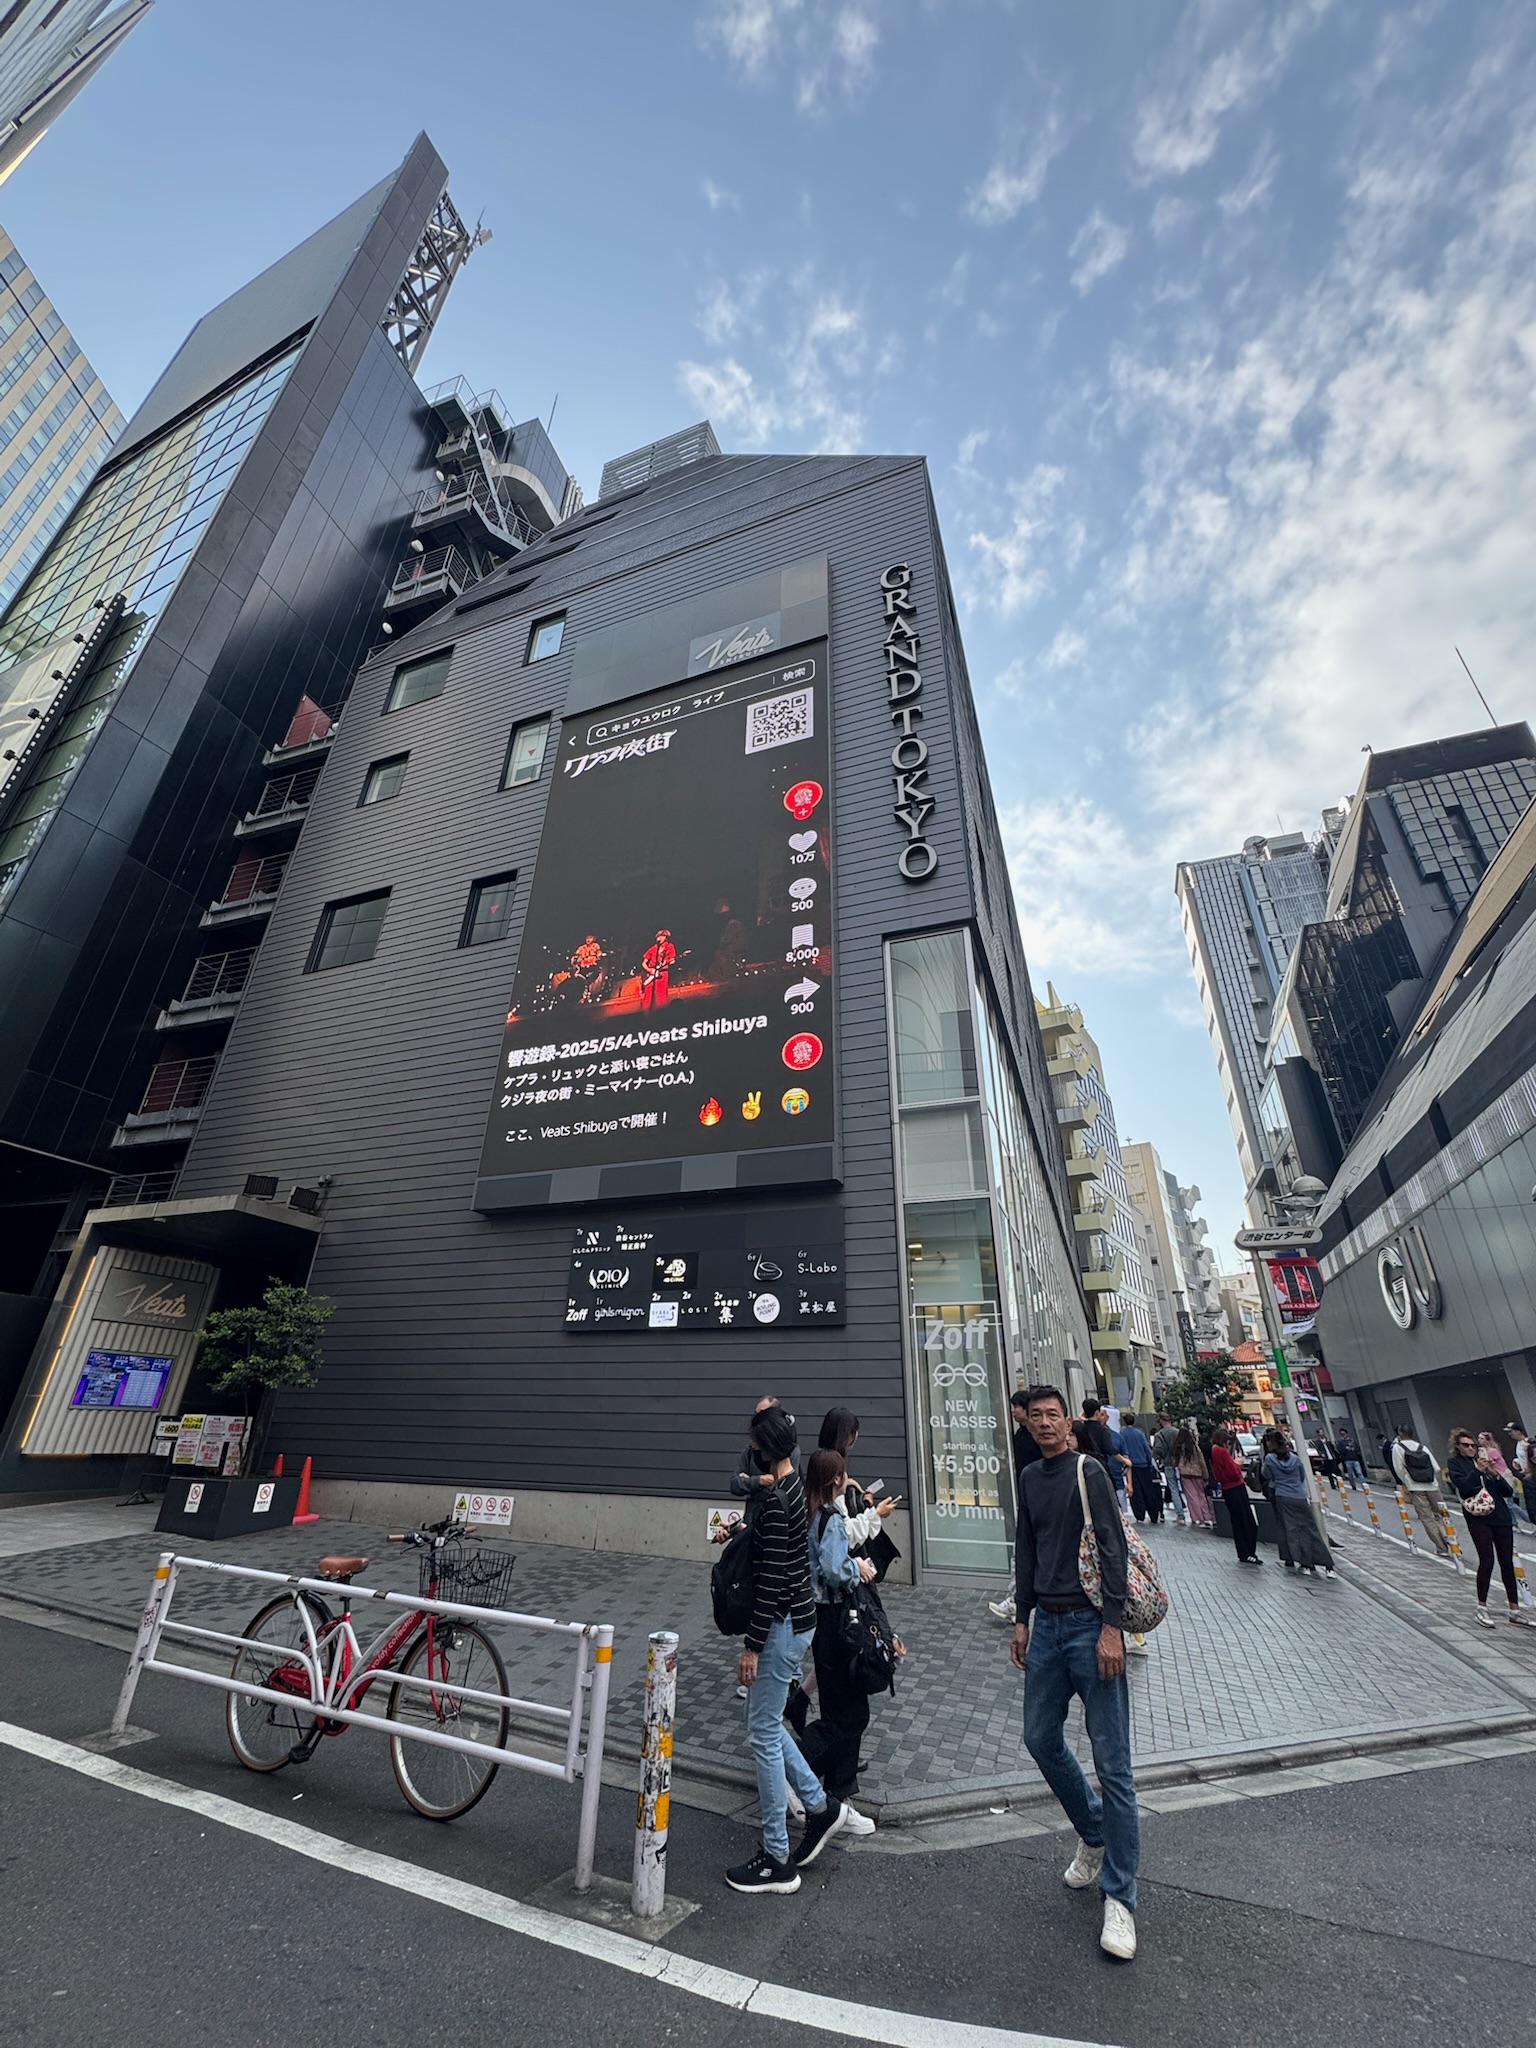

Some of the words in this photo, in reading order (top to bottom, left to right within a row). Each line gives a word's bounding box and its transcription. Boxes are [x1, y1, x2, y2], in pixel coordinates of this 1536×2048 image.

[880, 562, 923, 704] GRAND
[695, 626, 774, 669] Veats
[692, 691, 725, 709] ライブ
[782, 667, 806, 681] 検索
[891, 705, 939, 880] TOKYO
[790, 850, 816, 865] 10万
[791, 899, 814, 912] 500
[785, 947, 820, 964] 8,000
[790, 1001, 815, 1015] 900
[691, 1014, 768, 1038] Shibuya
[541, 1123, 571, 1139] Veats
[1243, 1229, 1315, 1242] 渋谷センター街
[747, 1253, 757, 1261] 6F
[797, 1250, 807, 1258] 6F
[798, 1261, 838, 1274] S-Labo
[597, 1269, 622, 1283] DIO
[1377, 1225, 1442, 1330] GU
[115, 1281, 187, 1318] Veats
[747, 1290, 757, 1300] 3F
[798, 1289, 807, 1298] 3F
[566, 1308, 588, 1321] Zoff
[799, 1300, 837, 1315] 黒松屋
[924, 1318, 989, 1351] Zoff
[945, 1399, 979, 1412] NEW
[930, 1415, 998, 1429] GLASSES
[942, 1441, 976, 1453] starting
[978, 1442, 988, 1451] at
[933, 1454, 1001, 1476] ¥5,500
[938, 1485, 948, 1496] in
[960, 1485, 987, 1498] short
[987, 1489, 999, 1498] as
[935, 1501, 960, 1519] 30
[964, 1502, 1006, 1521] min.
